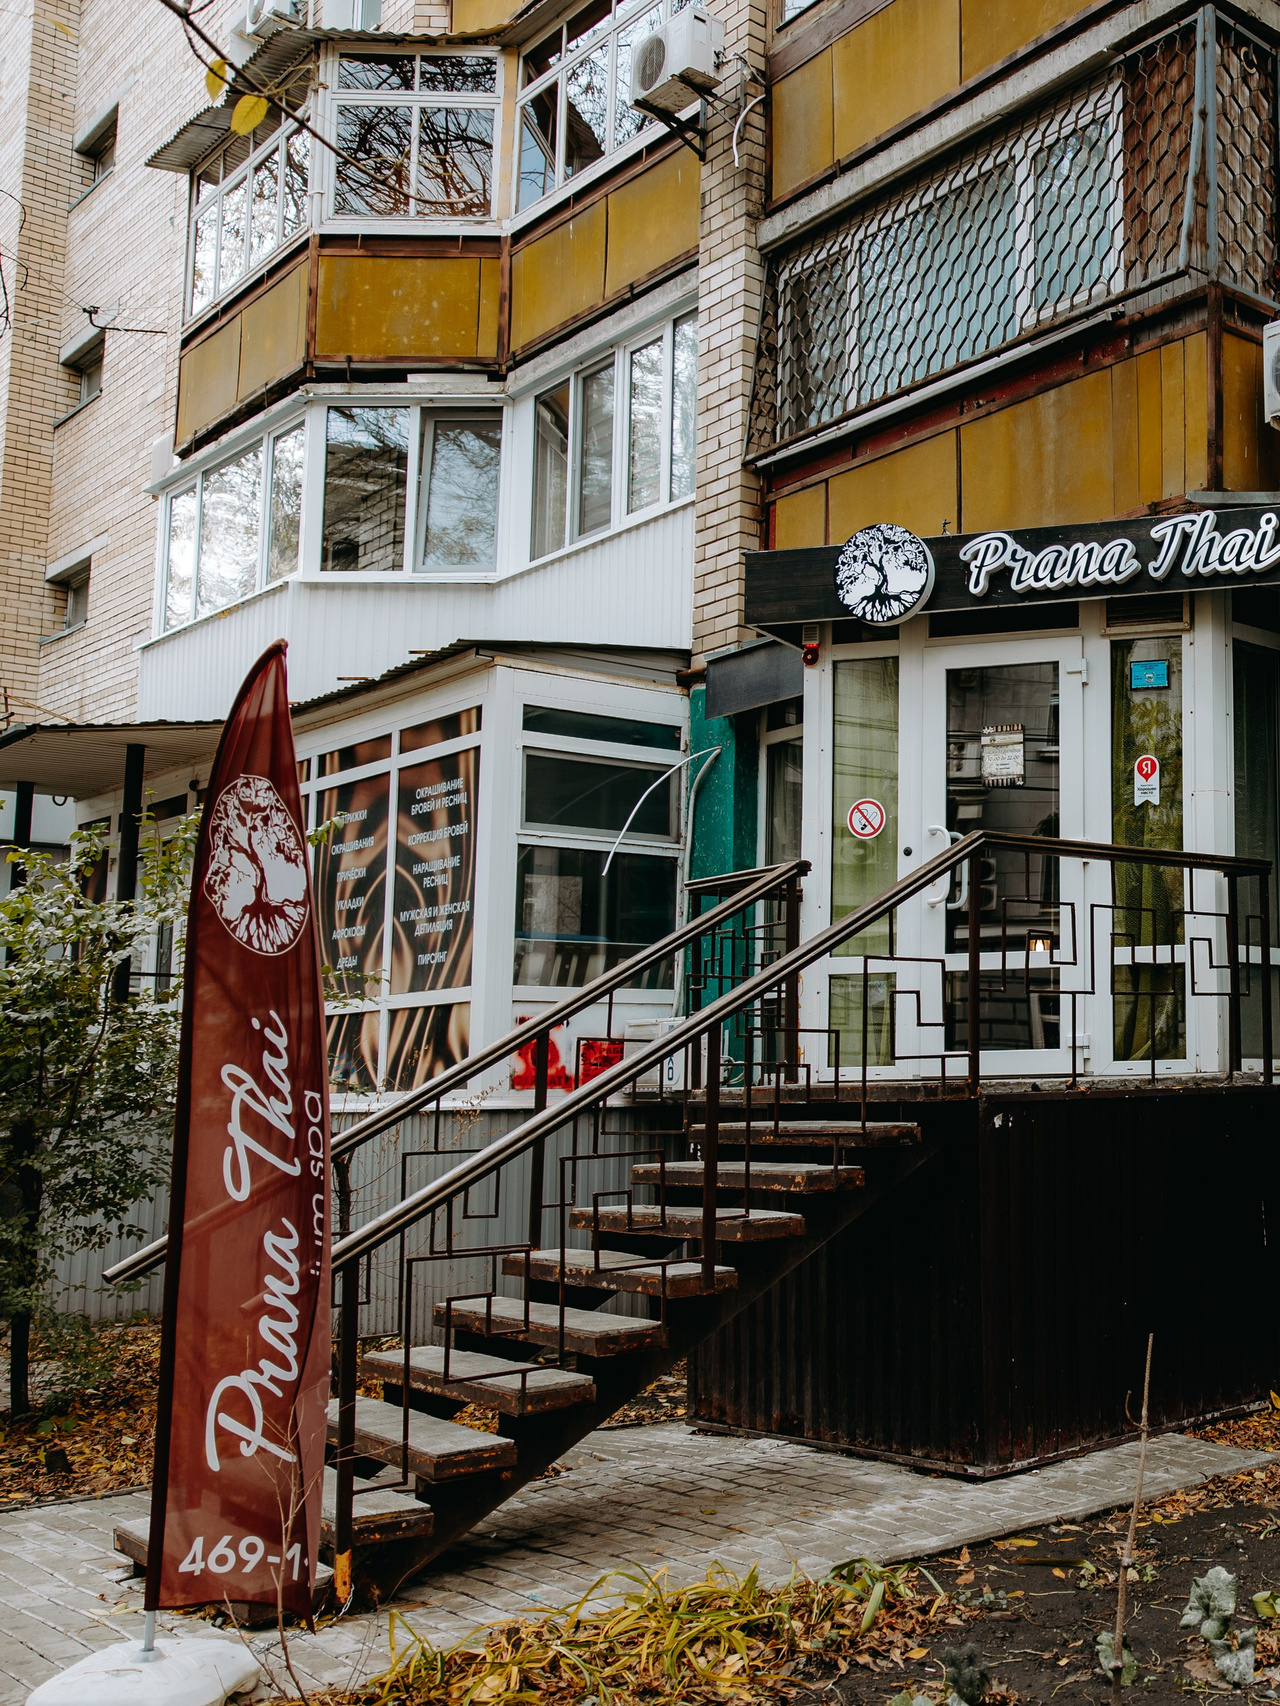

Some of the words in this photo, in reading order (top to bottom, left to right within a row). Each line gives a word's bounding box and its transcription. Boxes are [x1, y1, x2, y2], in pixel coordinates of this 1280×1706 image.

[959, 532, 1141, 597] Prana
[1142, 760, 1151, 774] Я
[416, 777, 464, 800] ОКРАШИВАНИЕ
[411, 798, 435, 816] БРОВЕЙ
[436, 799, 441, 810] И
[441, 792, 468, 808] РЕСНИЦ
[341, 809, 368, 824] ТРИЖКИ
[408, 829, 443, 846] КОРРЕКЦИЯ
[443, 820, 469, 838] БРОВЕЙ
[331, 836, 375, 855] ОКРАШИВАНИЯ
[412, 855, 461, 875] НАРАЩИВАНИЕ
[336, 867, 367, 883] ПРИЧЁСКИ
[423, 873, 449, 888] РЕСНИЦ
[336, 896, 364, 911] УКЛАДКИ
[399, 905, 433, 922] МУЖСКАЯ
[432, 905, 438, 917] И
[438, 900, 470, 916] ЖЕНСКАЯ
[331, 925, 366, 940] АФРОКОСЫ
[414, 919, 453, 937] ДЕПИЛЯЦИЯ
[336, 955, 358, 970] ДРЕДЫ
[417, 951, 447, 966] ПИРСИНГ
[221, 1009, 301, 1203] Thai
[206, 1217, 300, 1473] Prana
[178, 1535, 309, 1581] 469-1
